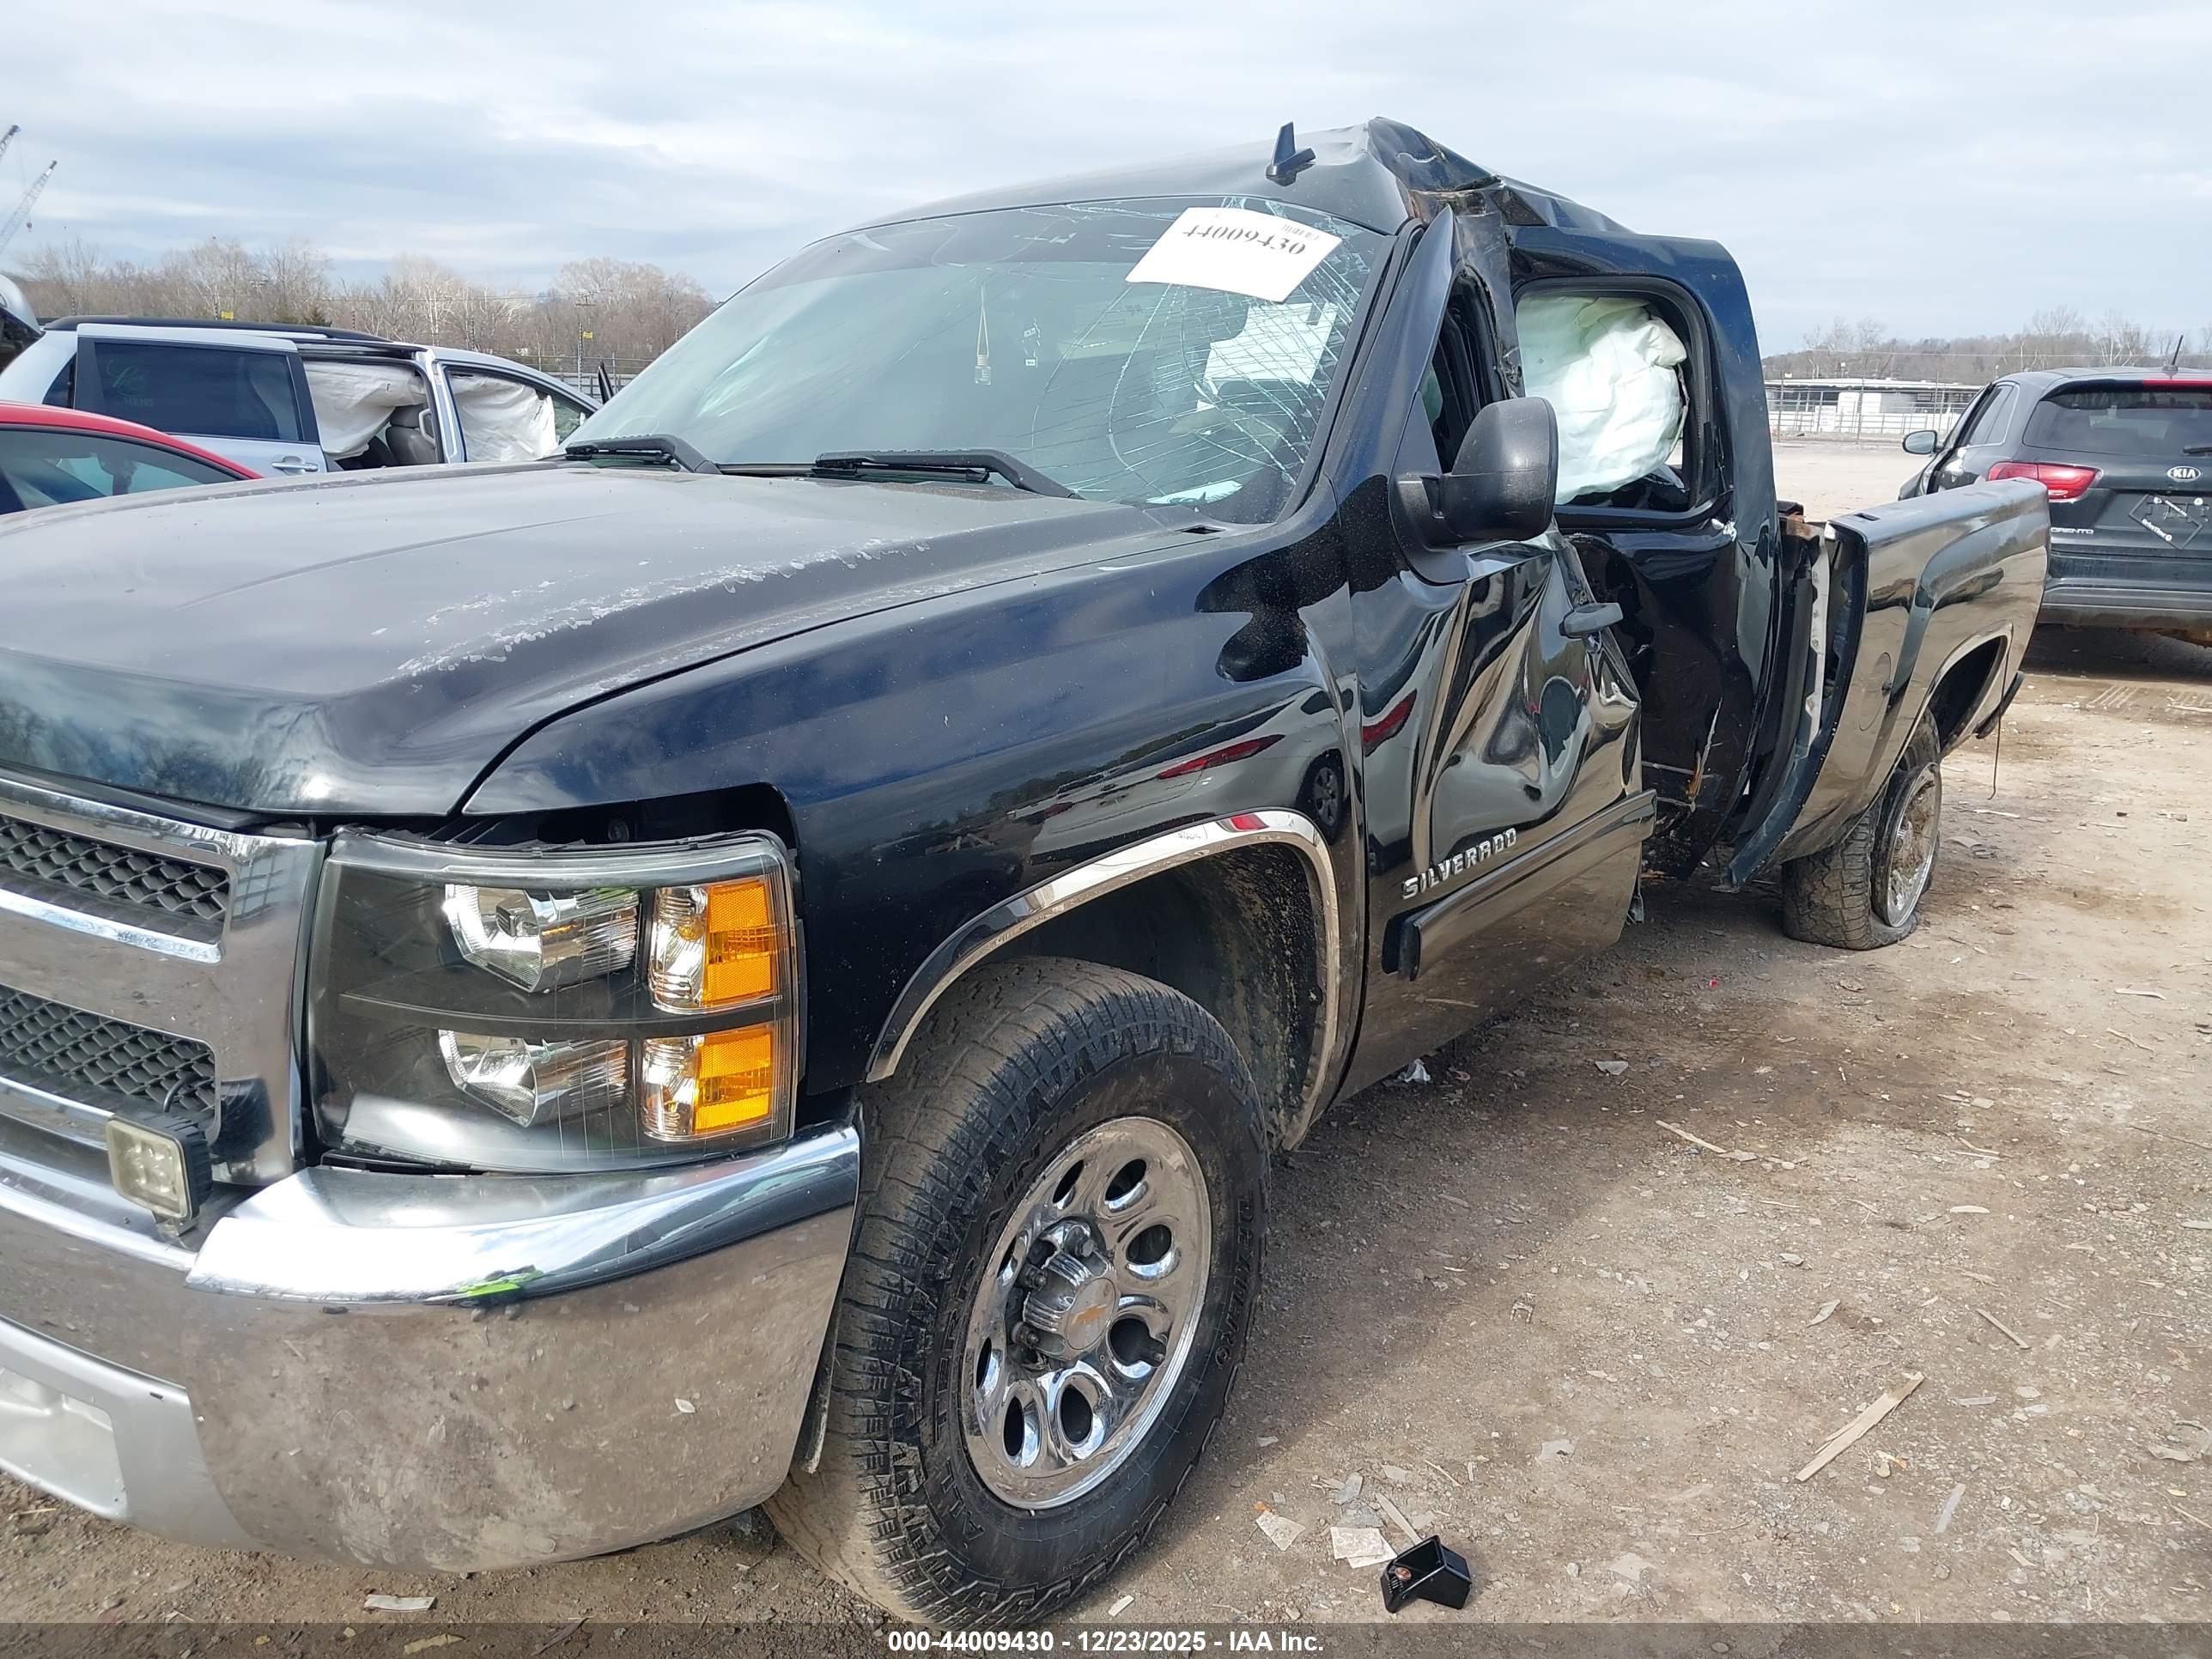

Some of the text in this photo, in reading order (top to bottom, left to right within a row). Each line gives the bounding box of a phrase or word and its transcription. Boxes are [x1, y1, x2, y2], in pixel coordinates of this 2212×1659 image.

[1182, 224, 1306, 255] 44009430
[2173, 468, 2196, 478] KIA
[1401, 827, 1517, 901] SILVERADO
